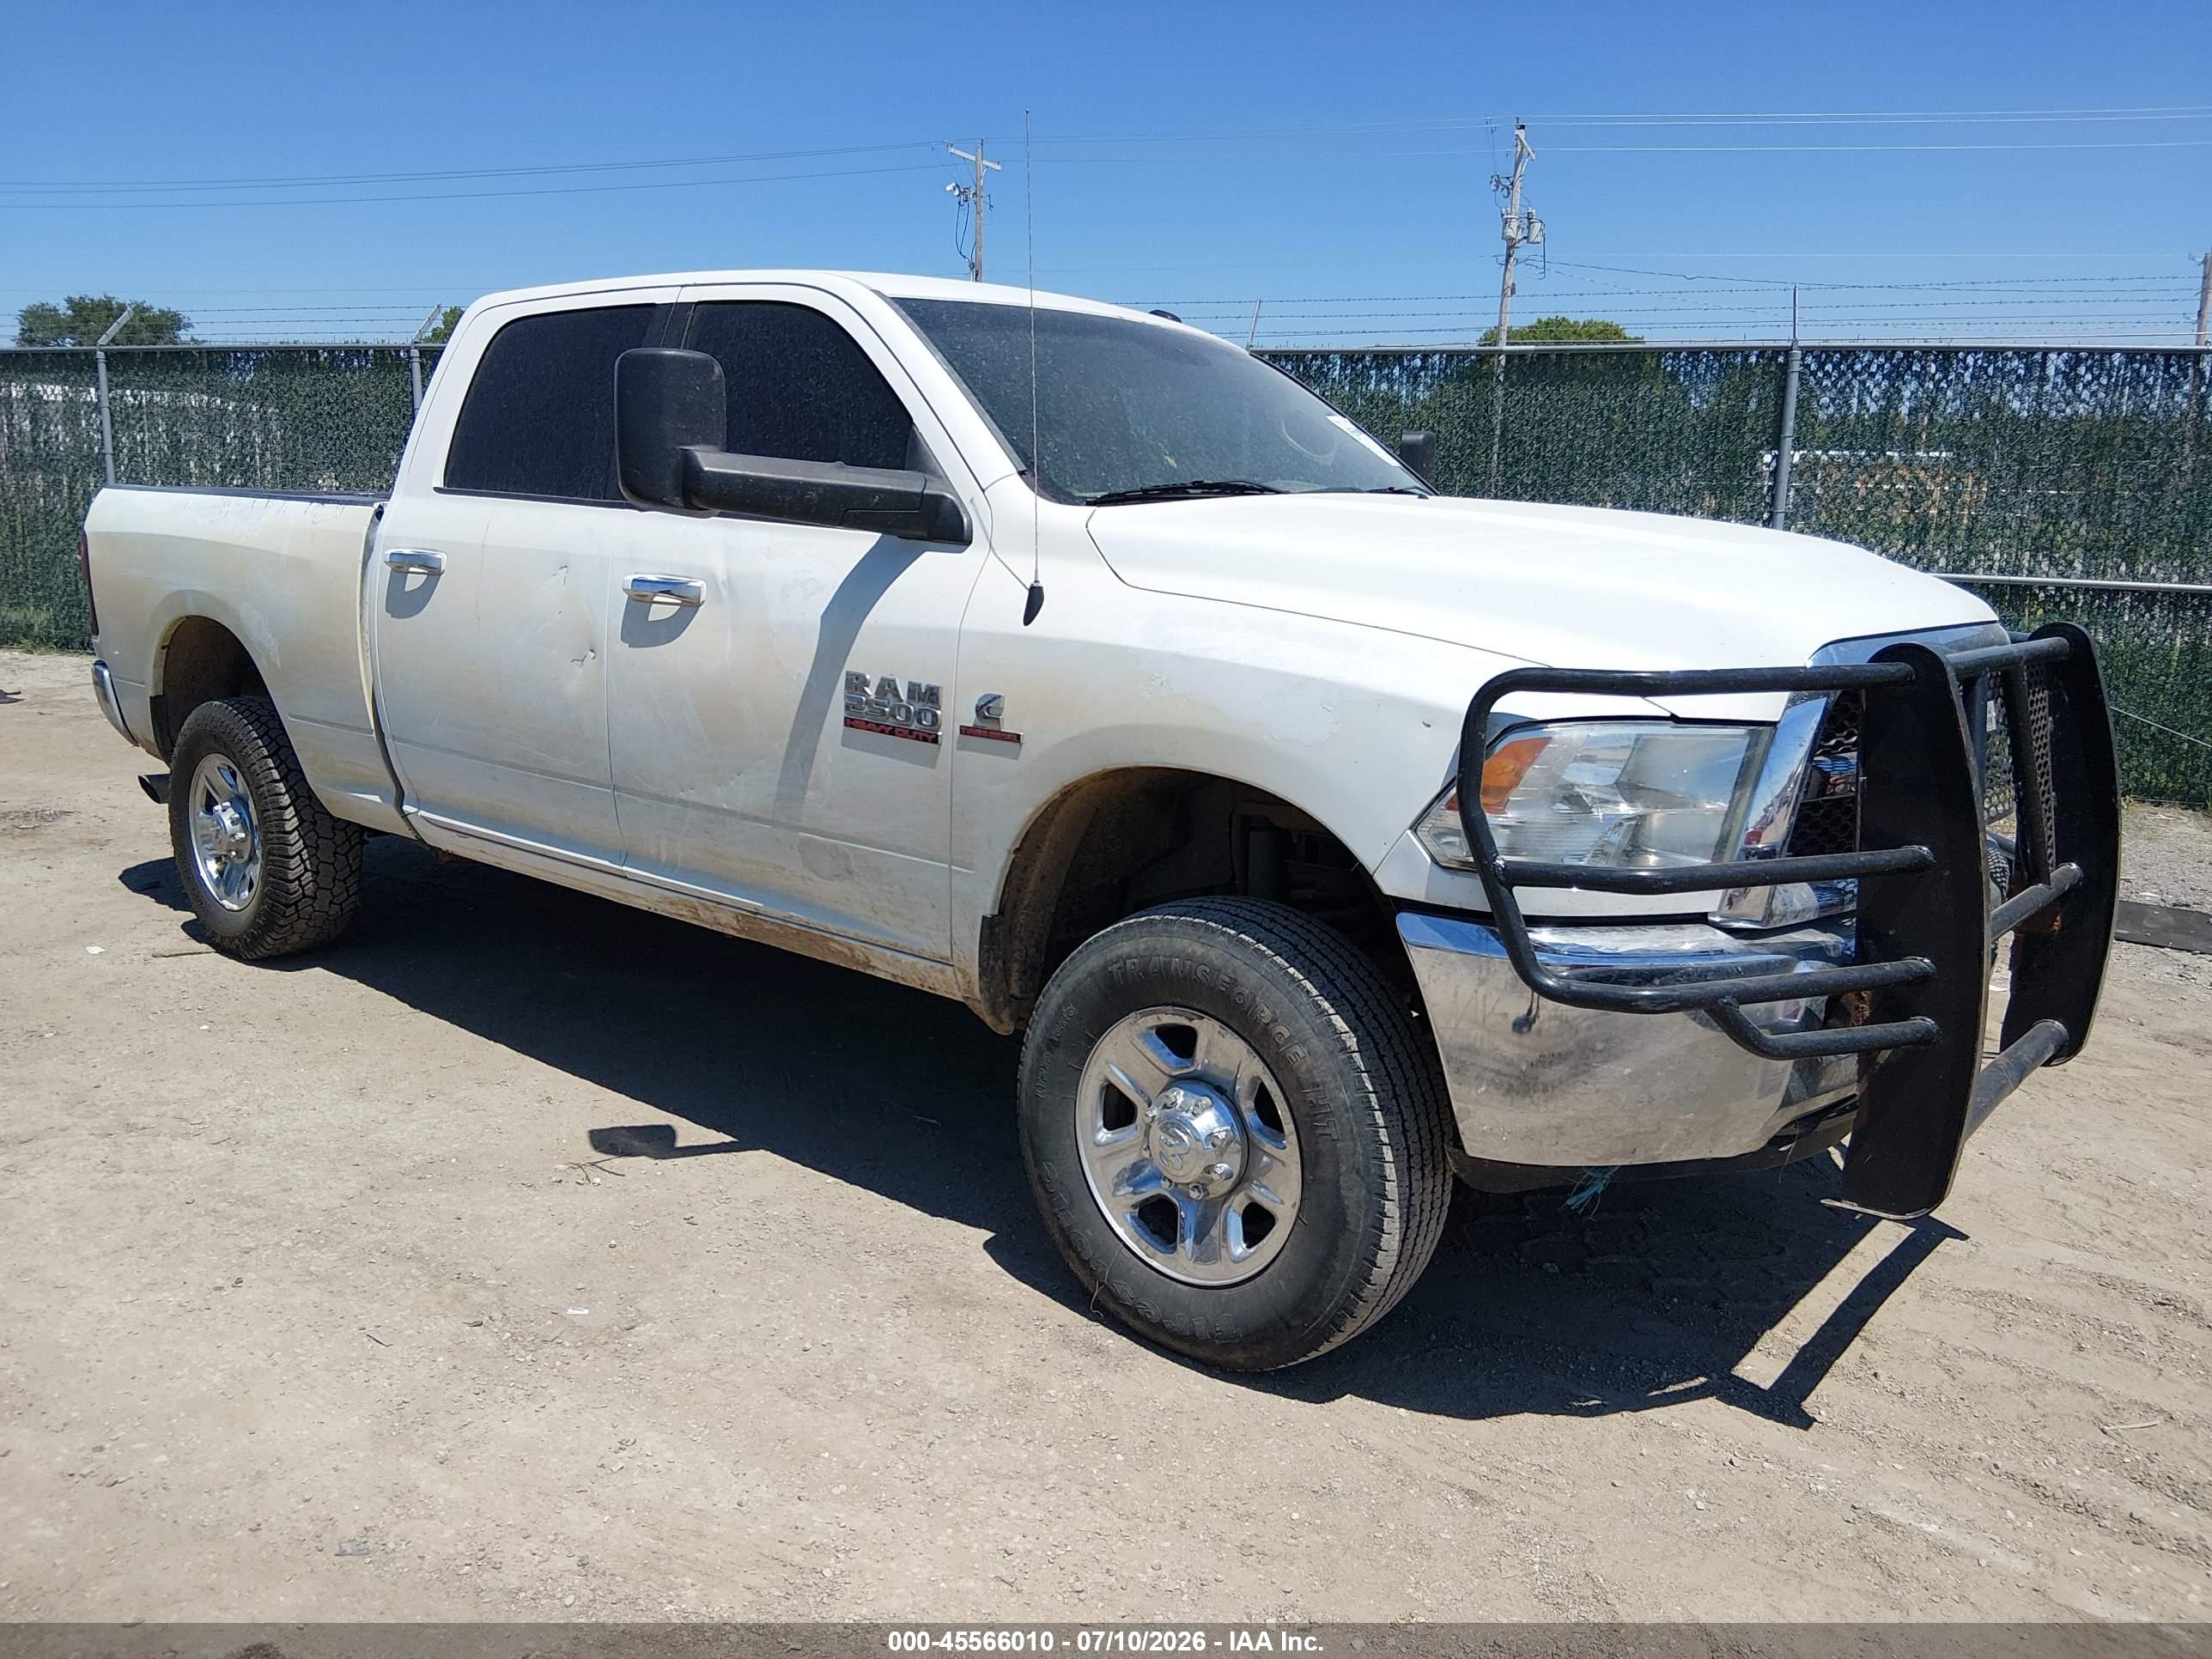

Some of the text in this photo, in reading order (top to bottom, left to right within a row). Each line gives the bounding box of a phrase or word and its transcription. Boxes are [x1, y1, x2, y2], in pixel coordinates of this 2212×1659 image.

[845, 671, 942, 707] RAM
[844, 692, 942, 731] 2500
[846, 718, 937, 744] HEAVY DUTY
[1108, 956, 1307, 1066] TRANSFORCE
